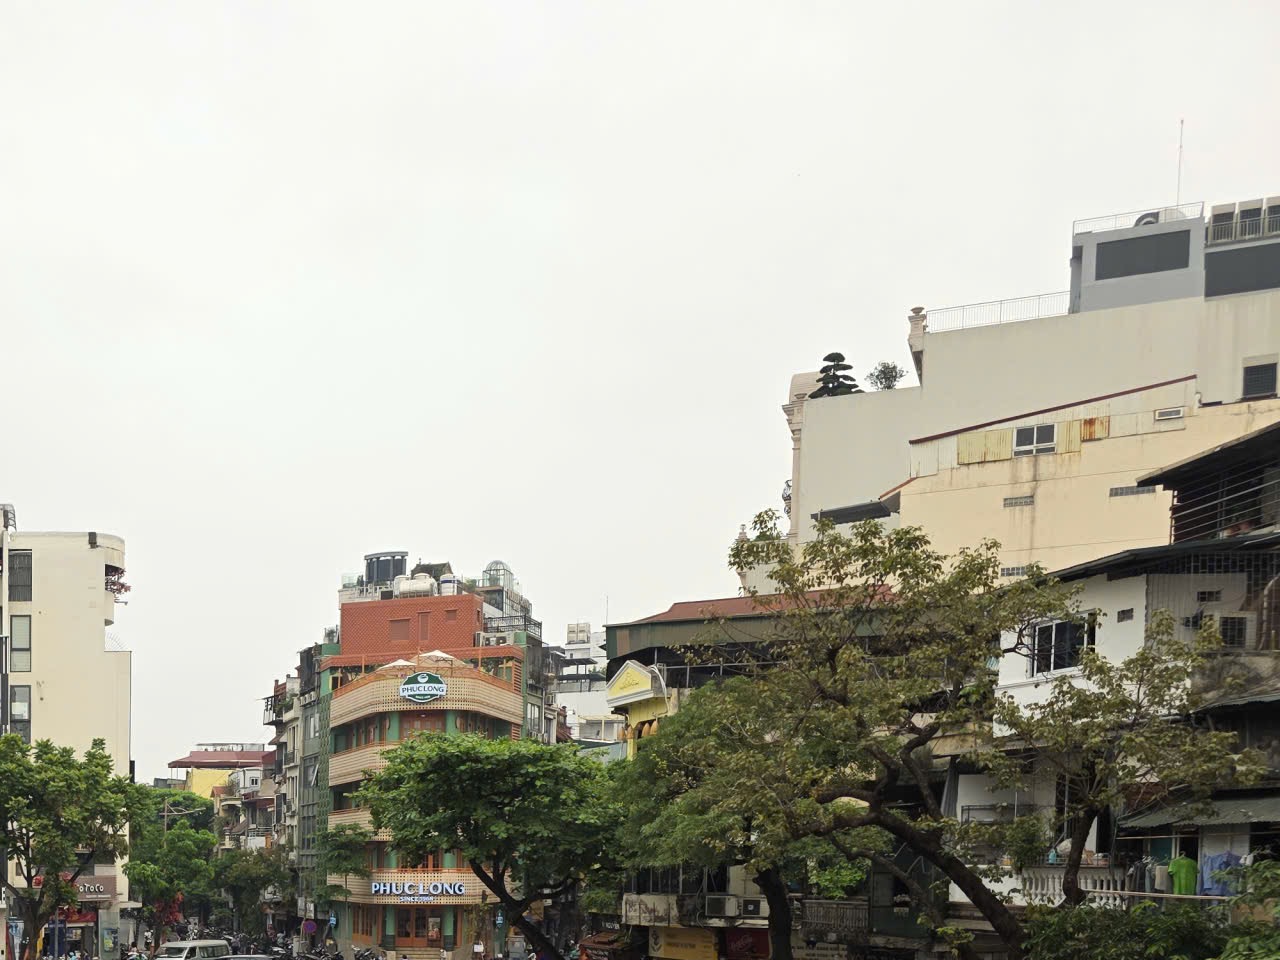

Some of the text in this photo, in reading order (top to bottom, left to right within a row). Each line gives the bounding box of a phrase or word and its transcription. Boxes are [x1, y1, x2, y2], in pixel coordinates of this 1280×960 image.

[402, 685, 444, 693] PHUC LONG
[371, 882, 465, 895] PHUC LONG
